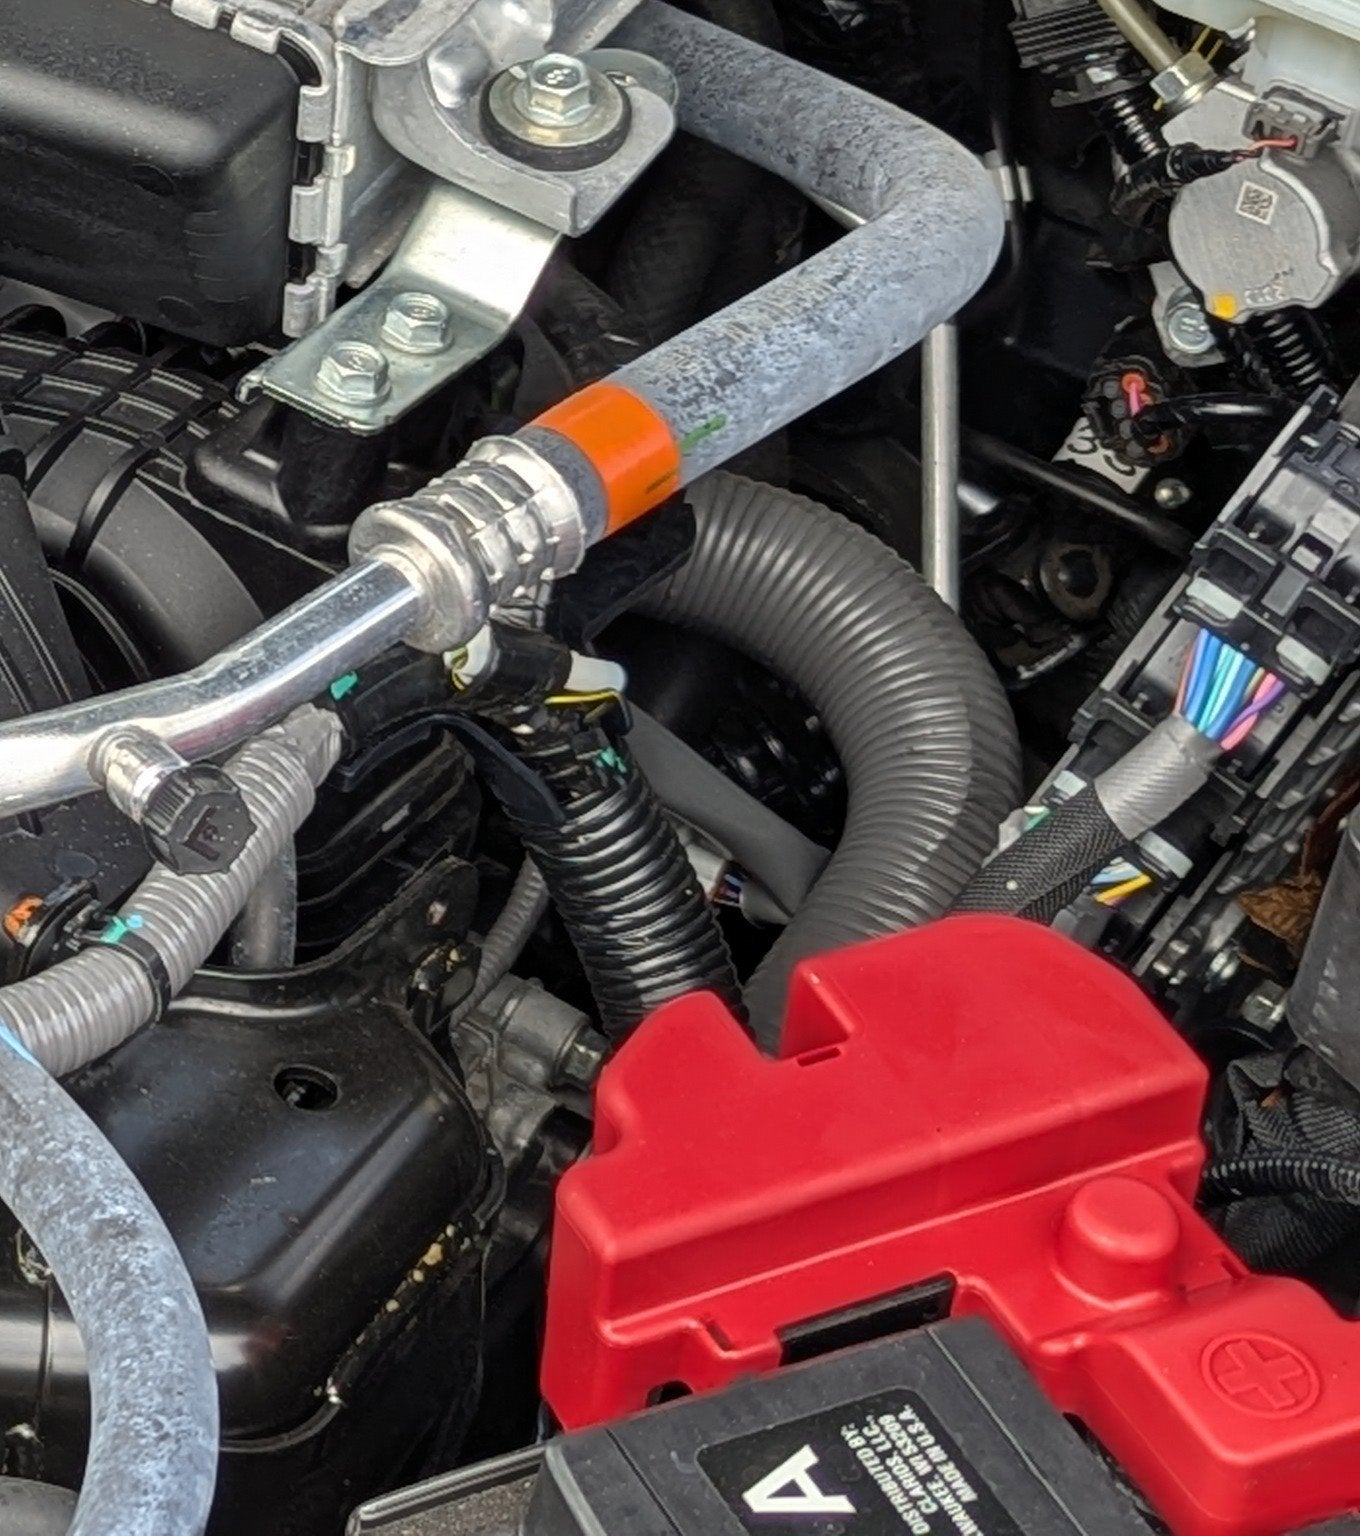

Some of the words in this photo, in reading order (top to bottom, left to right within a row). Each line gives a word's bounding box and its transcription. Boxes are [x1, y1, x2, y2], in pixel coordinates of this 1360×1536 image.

[840, 1422, 868, 1450] BY:
[877, 1414, 920, 1457] 53209
[924, 1445, 949, 1464] IN
[741, 1443, 857, 1514] A
[908, 1453, 934, 1477] WI
[936, 1461, 979, 1503] MADE
[856, 1447, 931, 1536] DISTRIBUTED
